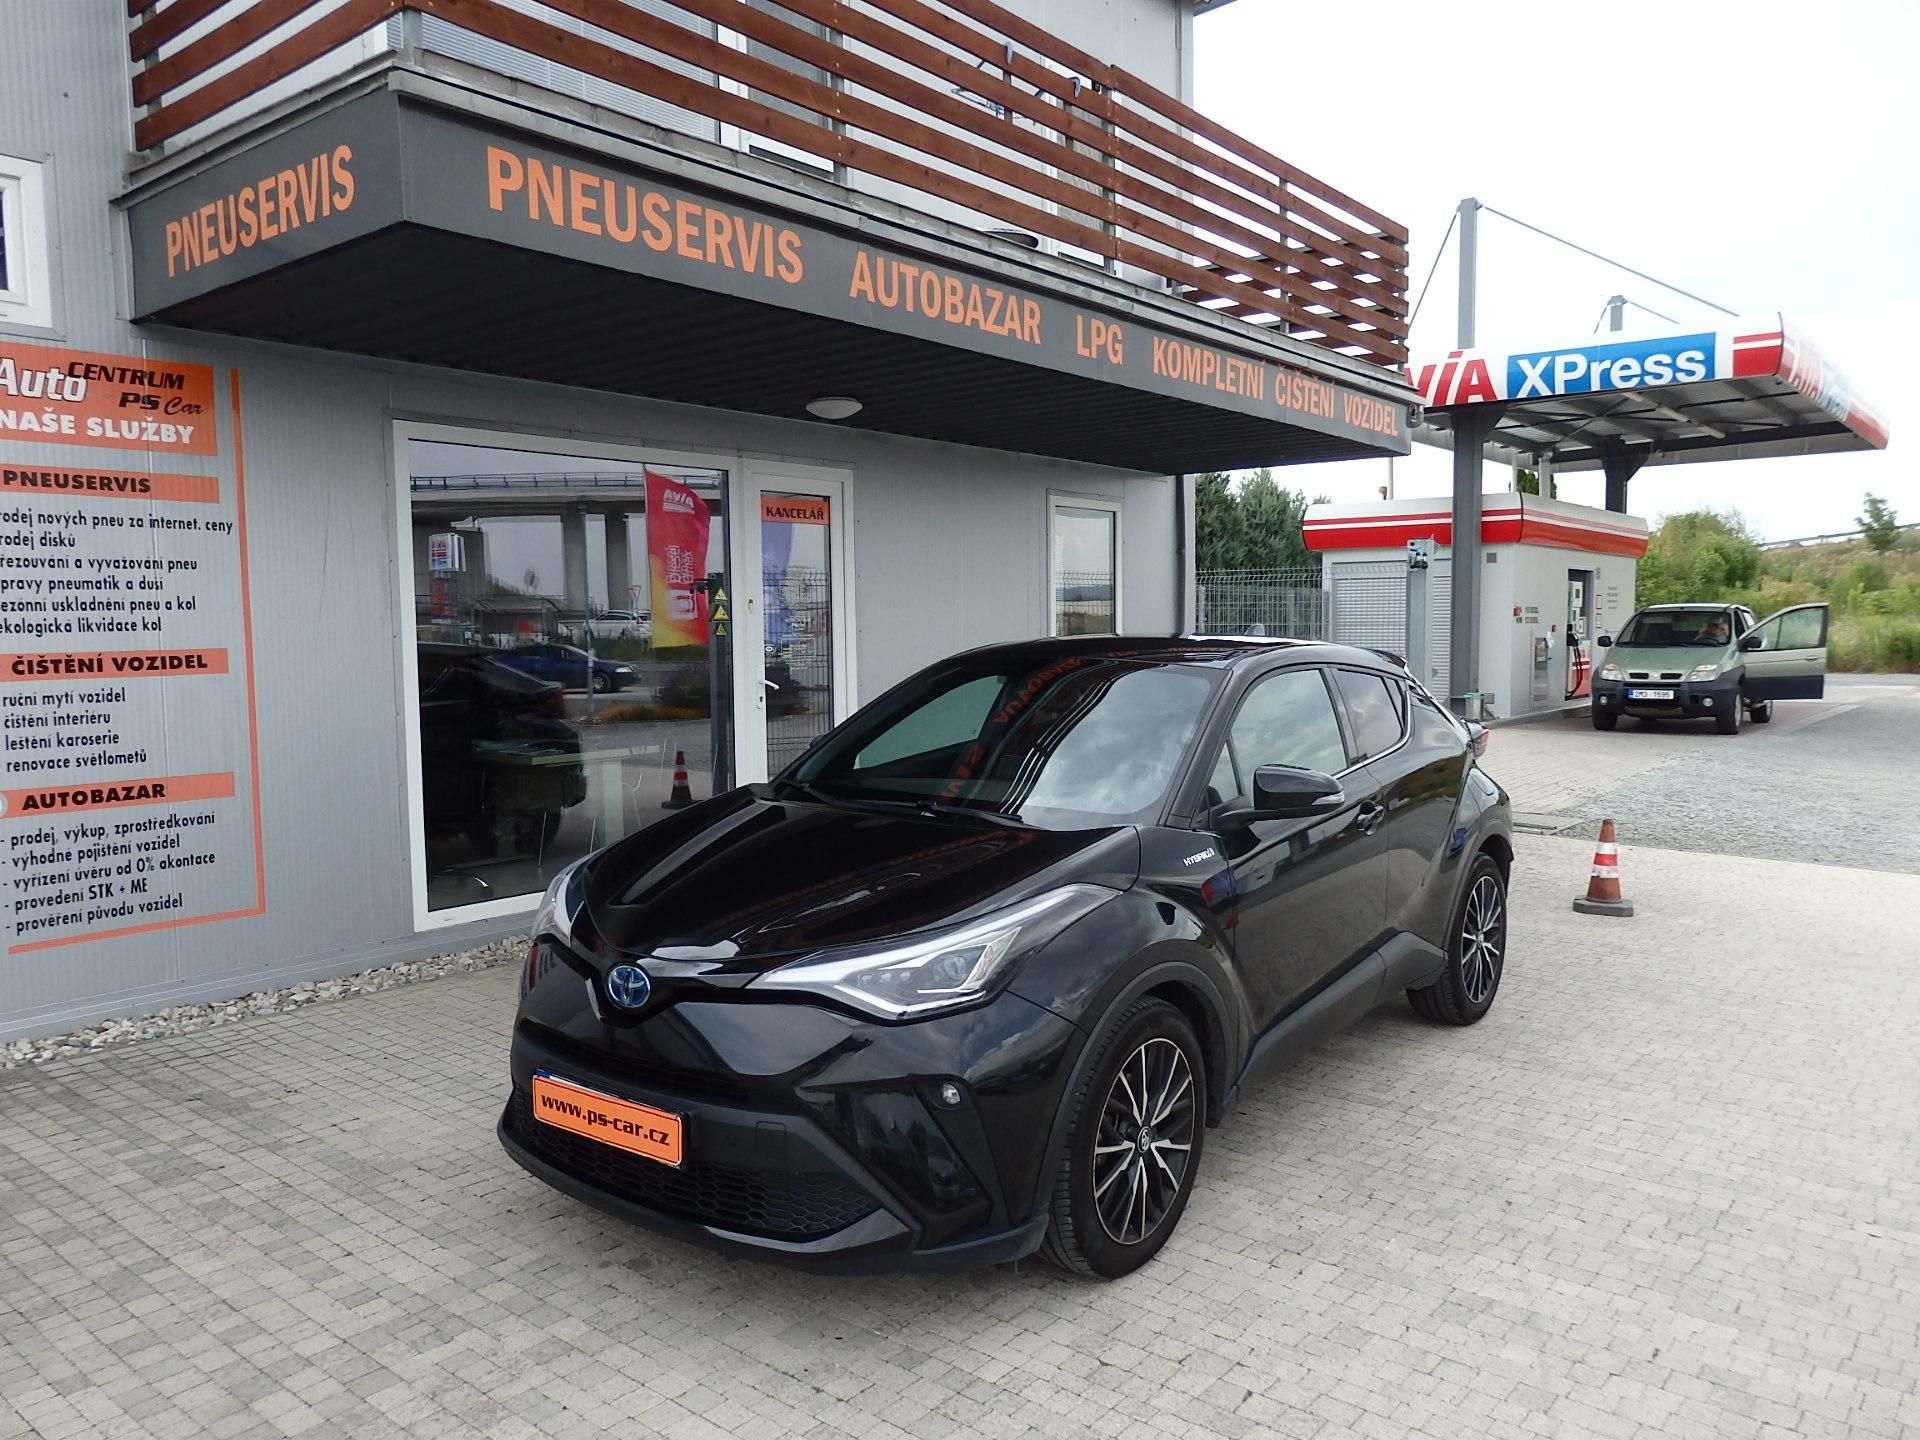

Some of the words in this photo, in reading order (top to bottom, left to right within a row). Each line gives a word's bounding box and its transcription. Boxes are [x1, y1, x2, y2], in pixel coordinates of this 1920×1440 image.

[165, 144, 355, 278] PNEUSERVIS
[487, 145, 804, 284] PNEUSERVIS
[848, 250, 1042, 345] AUTOBAZAR
[1075, 314, 1124, 366] LPG
[1153, 335, 1267, 400] KOMPLETNÍ
[1273, 363, 1336, 419] ČIŠTĚNÍ
[1343, 392, 1398, 437] VOZIDEL
[0, 356, 87, 403] Auto
[68, 361, 185, 390] CENTRUM
[1514, 348, 1708, 399] XPress
[119, 392, 161, 410] PS
[164, 397, 203, 415] Car
[0, 406, 76, 434] NAŠE
[86, 415, 195, 444] SLUŽBY
[3, 470, 151, 493] PNEUSERVIS
[38, 509, 87, 529] nových
[93, 515, 124, 528] pneu
[129, 516, 144, 528] za
[205, 520, 233, 535] ceny
[766, 505, 824, 520] KANCELÁŘ
[74, 558, 83, 569] a
[88, 553, 164, 574] vyvažování
[168, 558, 197, 574] pneu
[1, 579, 42, 594] pravy
[49, 575, 120, 594] pneumatik
[126, 580, 133, 590] a
[52, 595, 125, 613] uskladnění
[130, 599, 160, 614] pneu
[165, 600, 173, 611] a
[177, 595, 196, 611] kol
[78, 617, 137, 633] likvidace
[142, 616, 162, 633] kol
[11, 654, 104, 676] ČIŠTĚNÍ
[112, 654, 208, 672] VOZIDEL
[2, 691, 37, 707] ruční
[79, 687, 126, 703] vozidel
[4, 712, 49, 729] čištění
[53, 709, 111, 727] interiéru
[5, 734, 52, 751] leštění
[57, 730, 120, 748] karoserie
[6, 757, 71, 773] renovace
[76, 749, 147, 768] světlometů
[22, 783, 166, 811] AUTOBAZAR
[114, 810, 216, 836] zprostředkování
[12, 847, 73, 871] výhodné
[78, 839, 132, 864] pojištění
[137, 834, 181, 853] vozidel
[14, 869, 70, 893] vyřízení
[75, 862, 111, 881] úvěru
[116, 859, 132, 876] od
[136, 855, 154, 873] 0%
[160, 851, 216, 870] akontace
[15, 888, 84, 914] provedení
[89, 883, 114, 900] STK
[131, 877, 148, 895] ME
[16, 910, 83, 936] prověření
[87, 903, 134, 925] původu
[139, 893, 183, 913] vozidel
[541, 1093, 670, 1147] www.ps-car.cz
